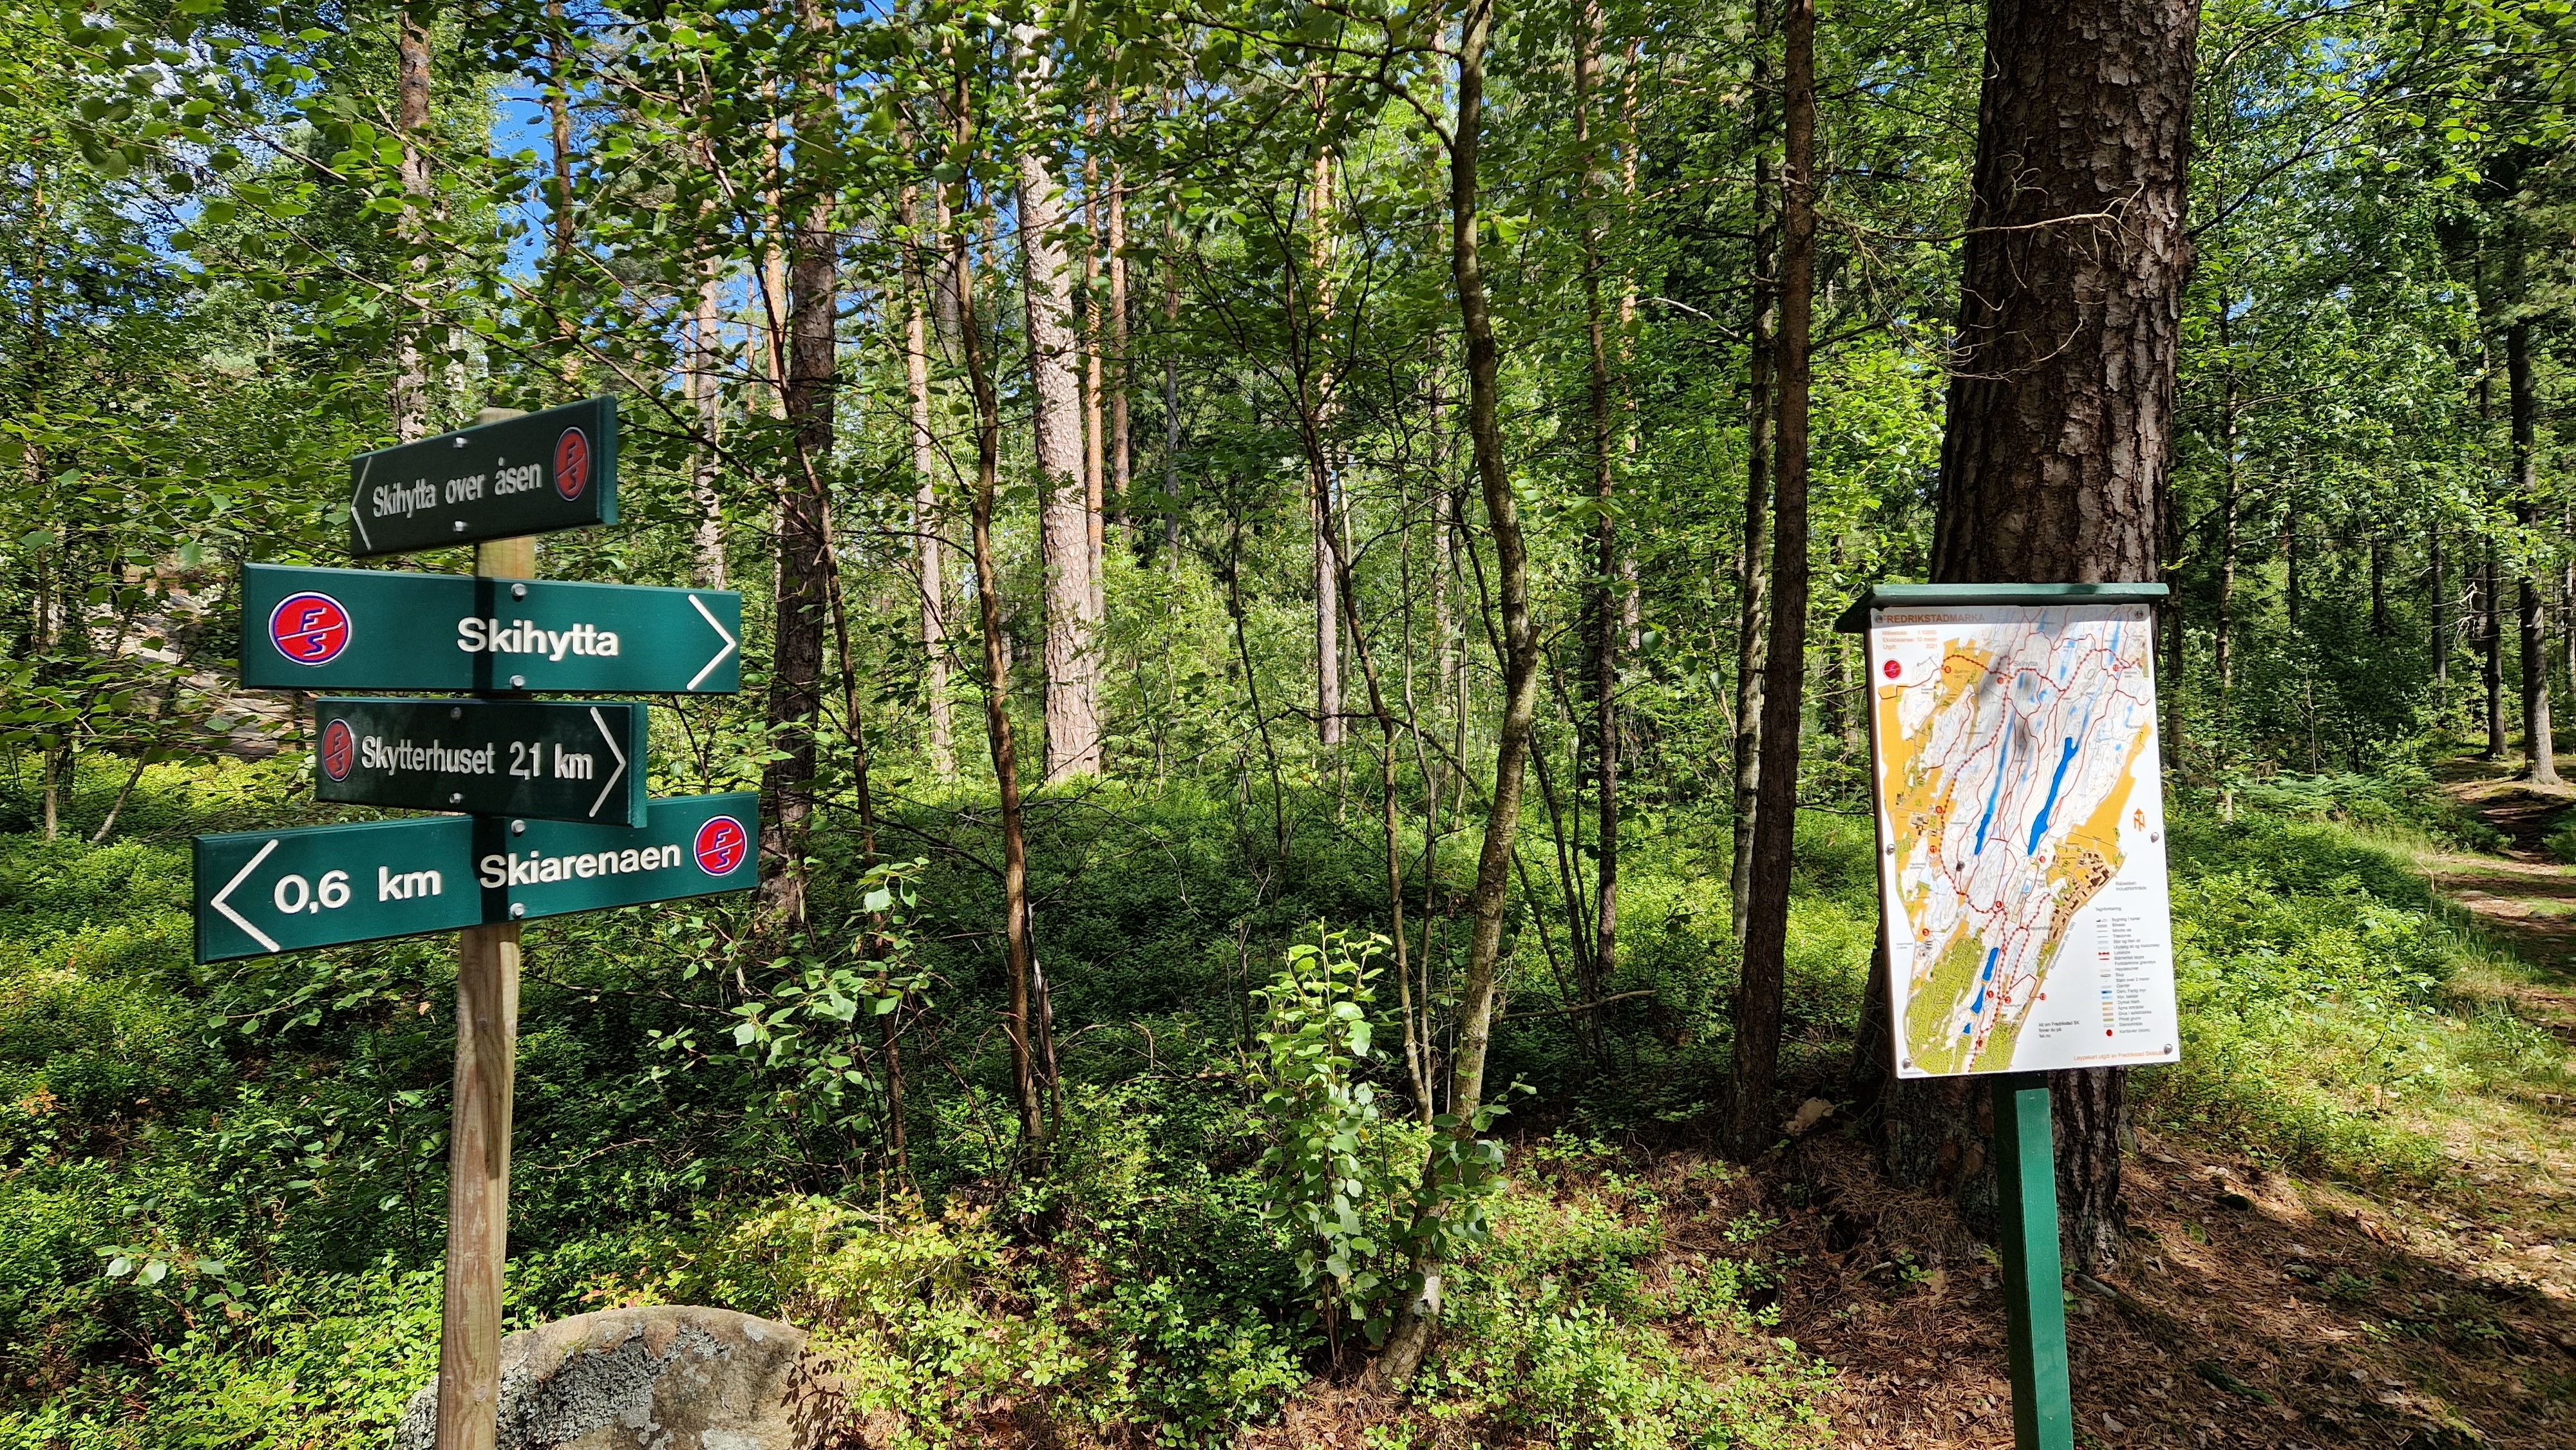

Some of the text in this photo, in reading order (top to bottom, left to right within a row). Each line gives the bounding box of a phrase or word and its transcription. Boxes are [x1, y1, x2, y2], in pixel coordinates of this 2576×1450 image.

[373, 457, 542, 518] Skihytta over åsen
[457, 616, 619, 662] Skihytta
[361, 735, 593, 780] Skytterhuset 2,1 km
[274, 843, 681, 915] 0,6 km Skiarenaen
